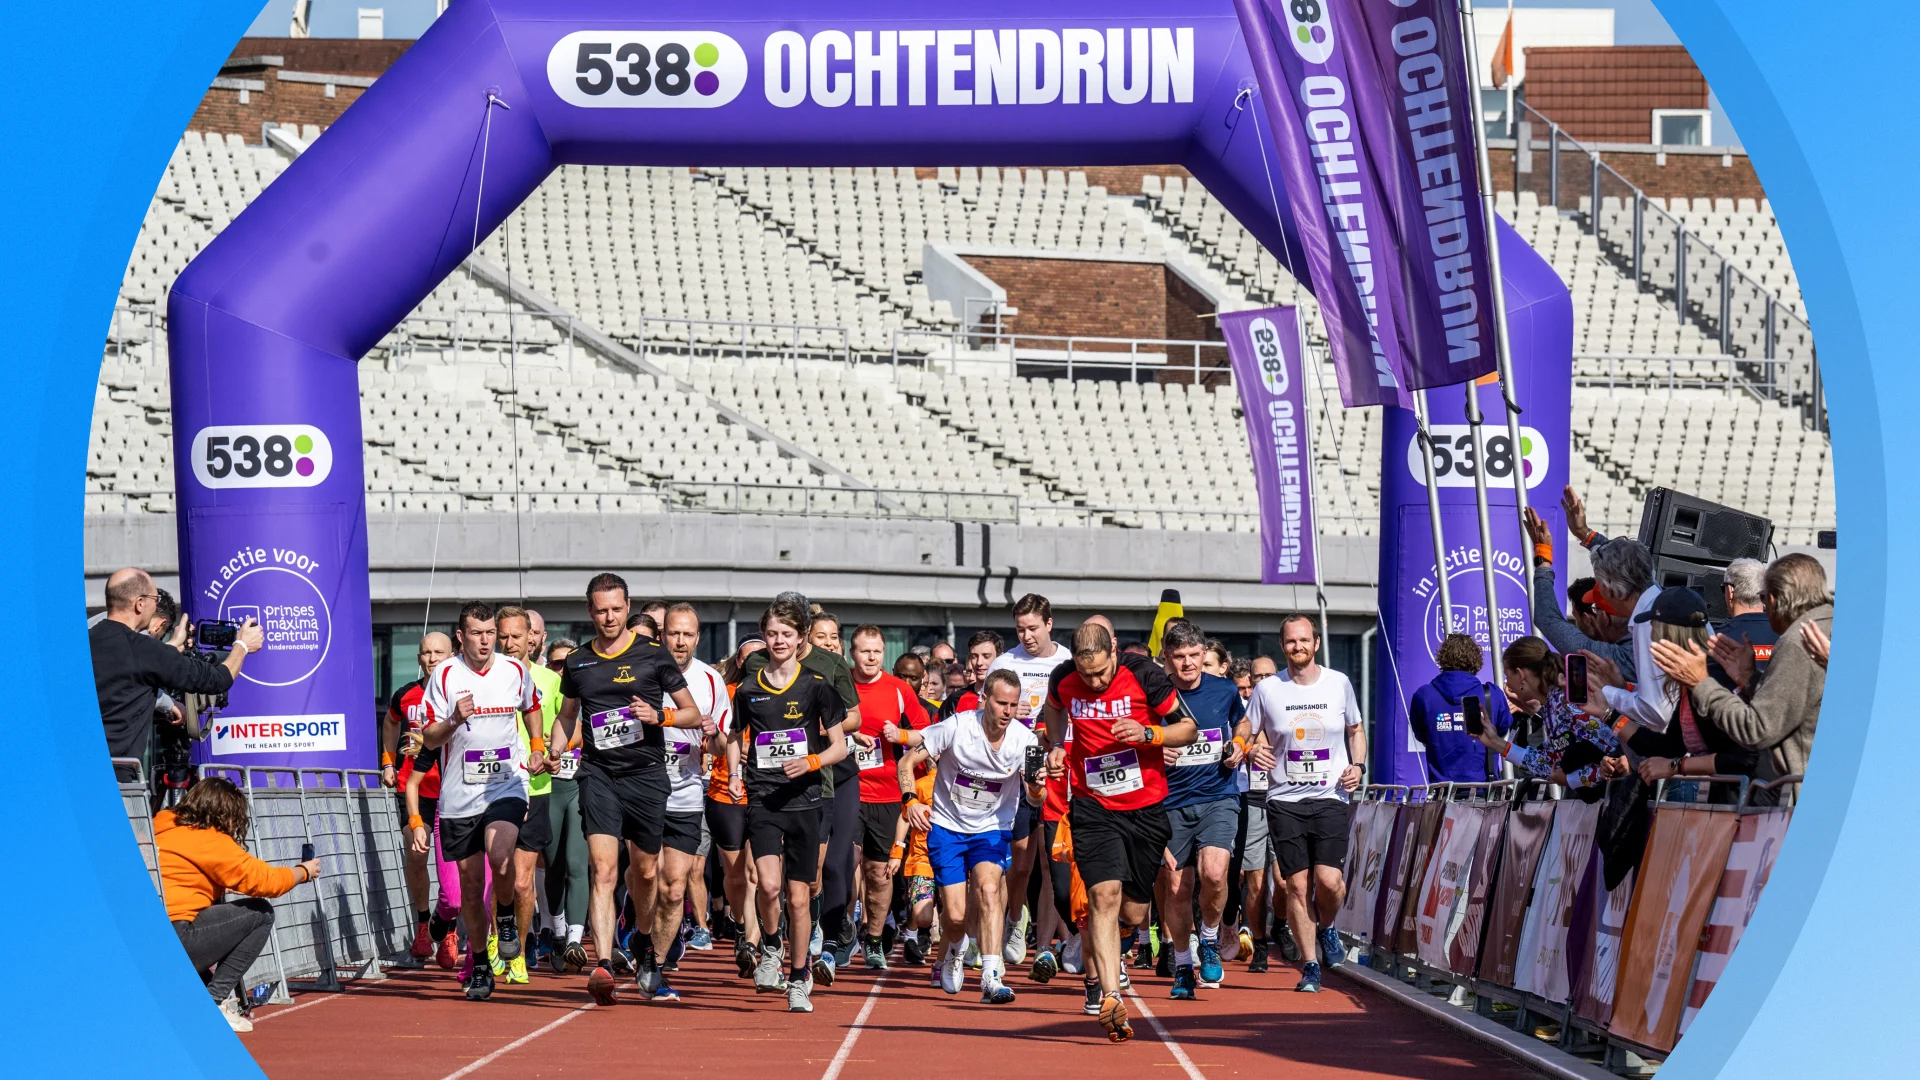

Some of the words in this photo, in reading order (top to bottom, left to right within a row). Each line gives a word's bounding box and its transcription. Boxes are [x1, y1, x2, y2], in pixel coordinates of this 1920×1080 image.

[575, 42, 691, 97] 538
[764, 27, 1194, 108] OCHTENDRUN
[206, 434, 293, 478] 538
[204, 579, 224, 600] in
[219, 546, 267, 580] actie
[273, 547, 320, 574] voor
[1412, 577, 1434, 598] in
[263, 605, 315, 621] prinses
[1472, 606, 1523, 620] prnses
[266, 616, 319, 631] máxima
[267, 629, 319, 642] centrum
[267, 643, 319, 651] kinderoncologie
[1070, 695, 1132, 718] Dirk.nl
[1285, 703, 1328, 711] #RUNSANDER
[230, 721, 340, 739] INTERSPORT
[603, 722, 630, 738] 246
[769, 744, 795, 757] 245
[1186, 743, 1211, 756] 230
[477, 761, 501, 774] 210
[1302, 761, 1315, 773] 11
[1099, 768, 1126, 785] 150
